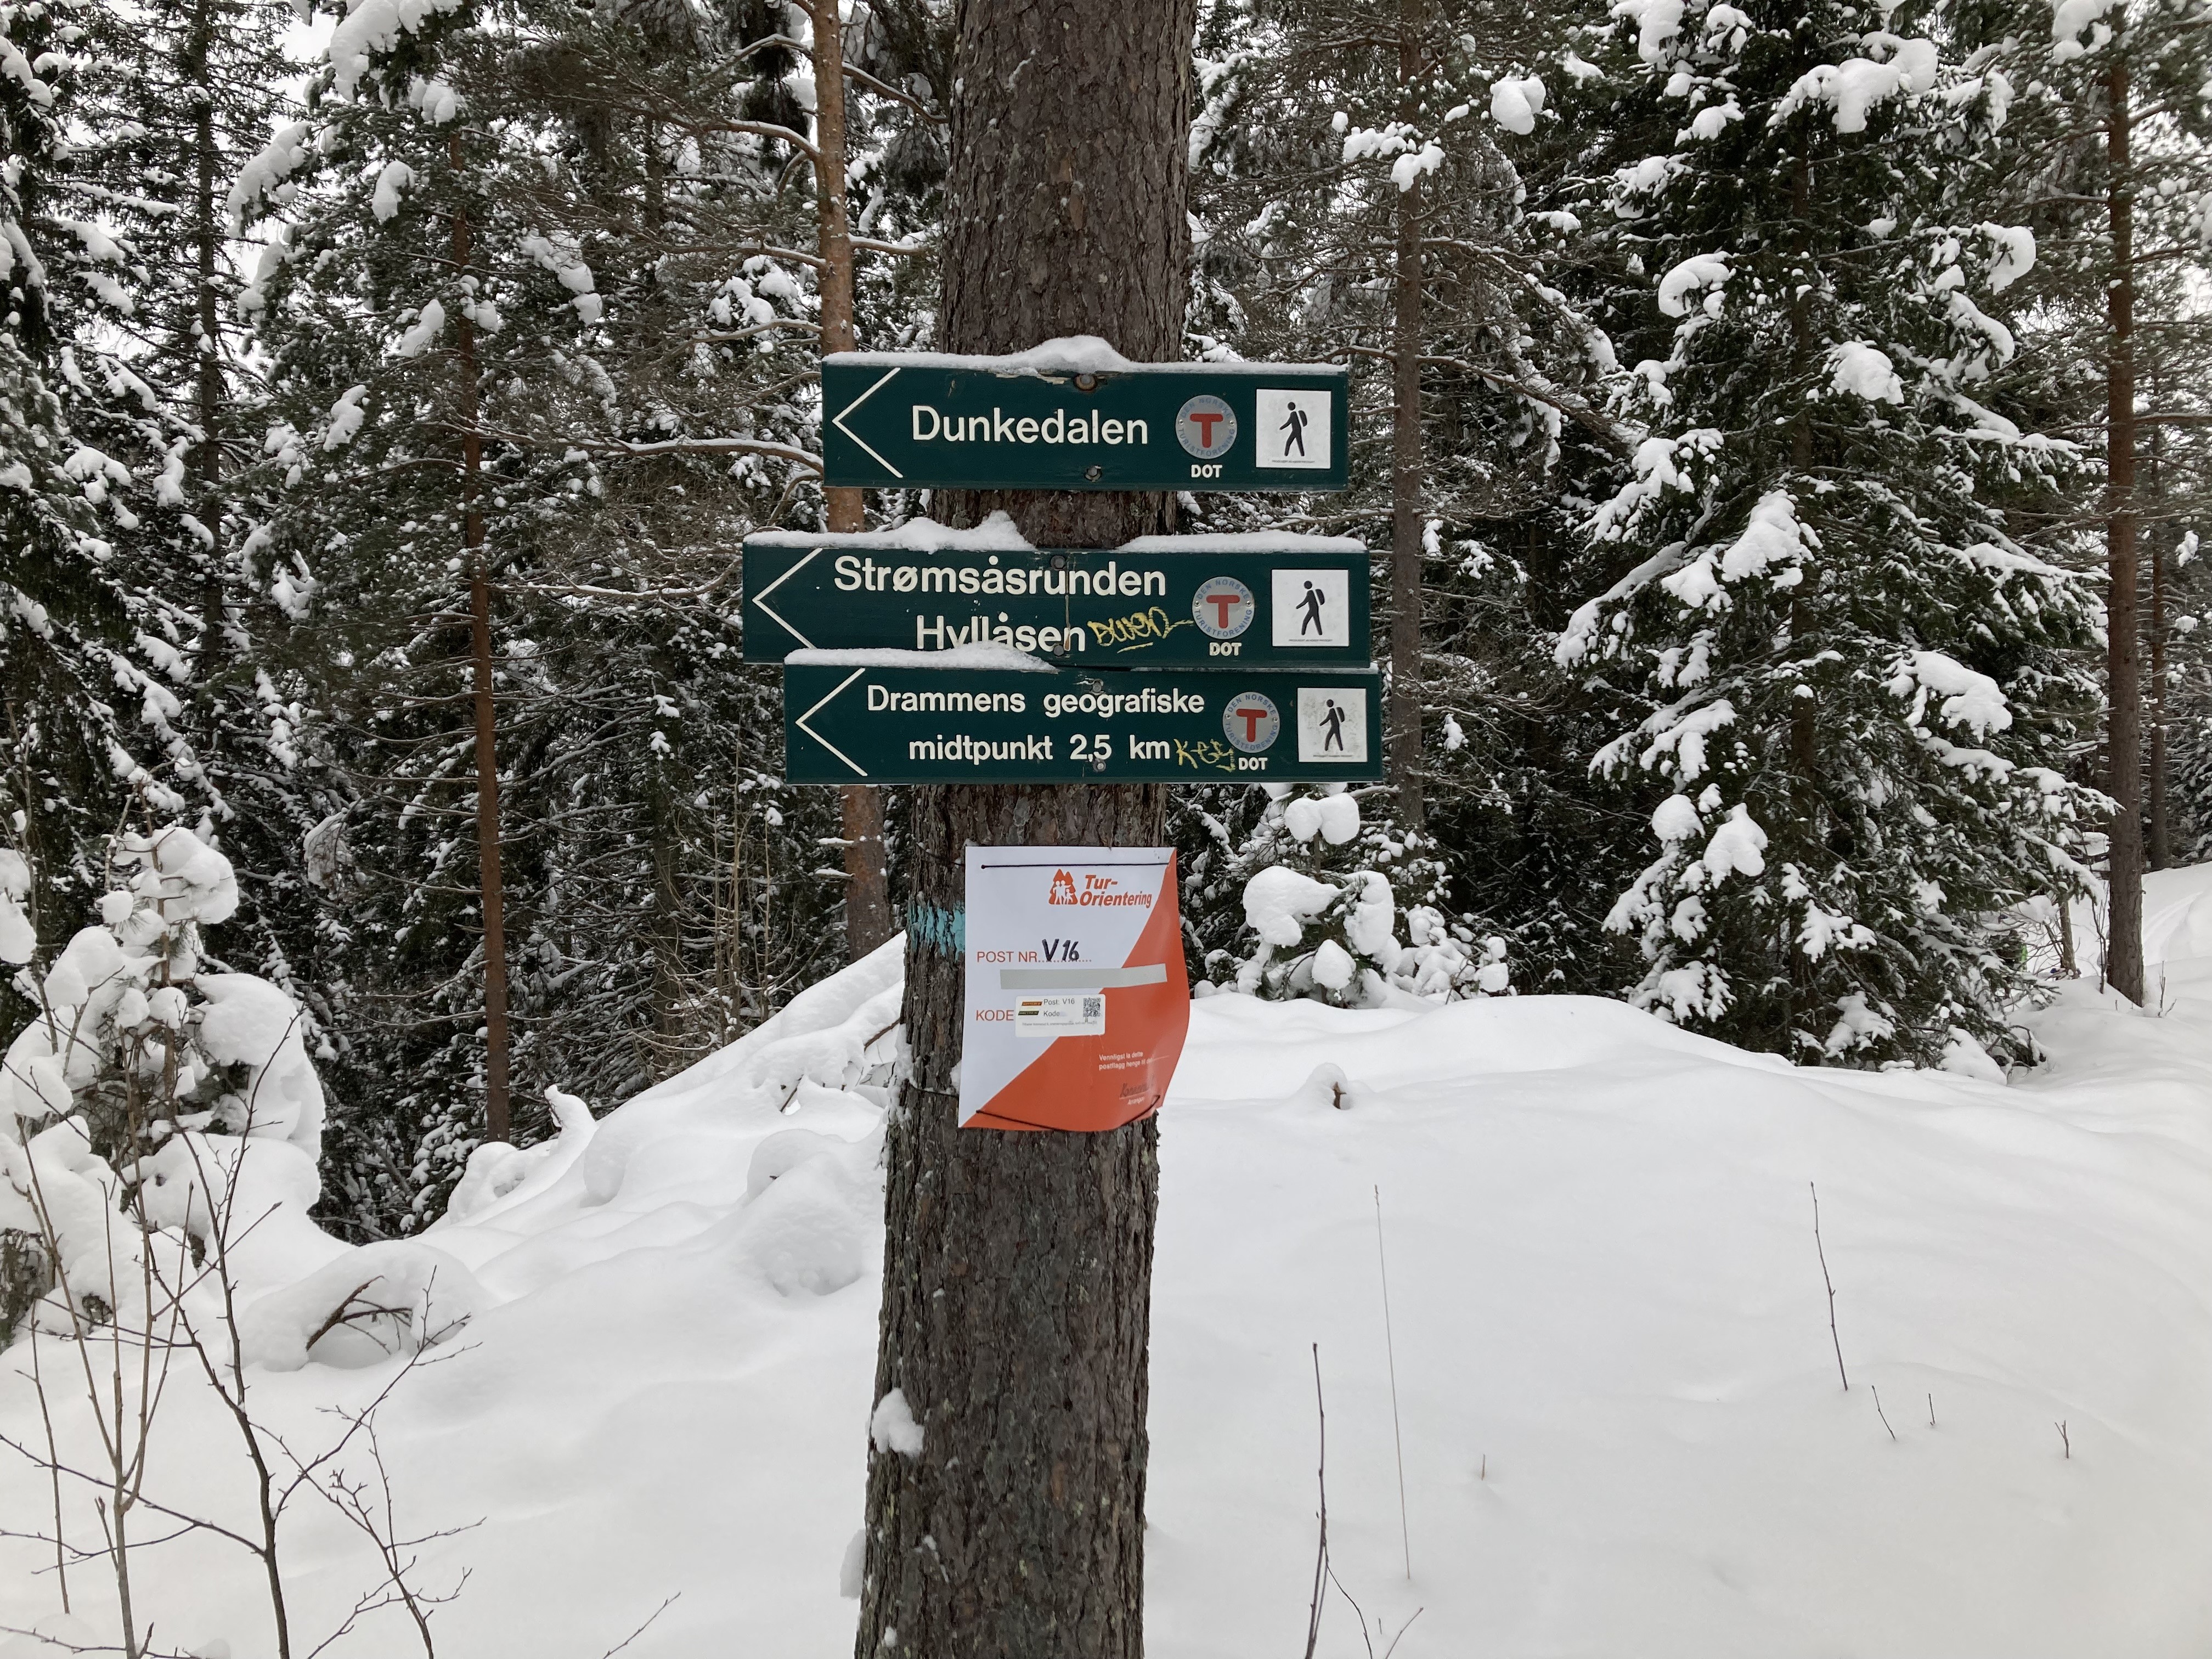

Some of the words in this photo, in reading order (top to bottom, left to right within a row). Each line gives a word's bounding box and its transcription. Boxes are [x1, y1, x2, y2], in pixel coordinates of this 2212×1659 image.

[912, 405, 1148, 445] Dunkedalen
[1189, 413, 1223, 448] T
[1190, 464, 1223, 478] DOT
[834, 555, 1166, 596] Strømsåsrunden
[1197, 584, 1212, 600] DEN
[1215, 579, 1250, 600] NORSKE
[1194, 609, 1252, 637] TURISTFORENING
[1206, 595, 1240, 629] T
[917, 612, 1085, 652] Hyllåsen
[1209, 642, 1242, 656] DOT
[868, 685, 1025, 713] Drammens
[1043, 687, 1205, 718] geografiske
[1227, 698, 1242, 713] DEN
[1245, 694, 1276, 715] NORSKE
[1226, 722, 1278, 751] TURISTFORENING
[1236, 708, 1267, 743] T
[910, 734, 1053, 765] midtpunkt
[1070, 734, 1112, 761] 2,5
[1130, 735, 1170, 759] km
[1238, 757, 1268, 771] DOT
[1085, 874, 1118, 889] Tur-
[1079, 891, 1152, 909] Orientering
[977, 951, 1014, 963] POST
[976, 1009, 1014, 1021] KODE
[1099, 1063, 1125, 1071] postflagg
